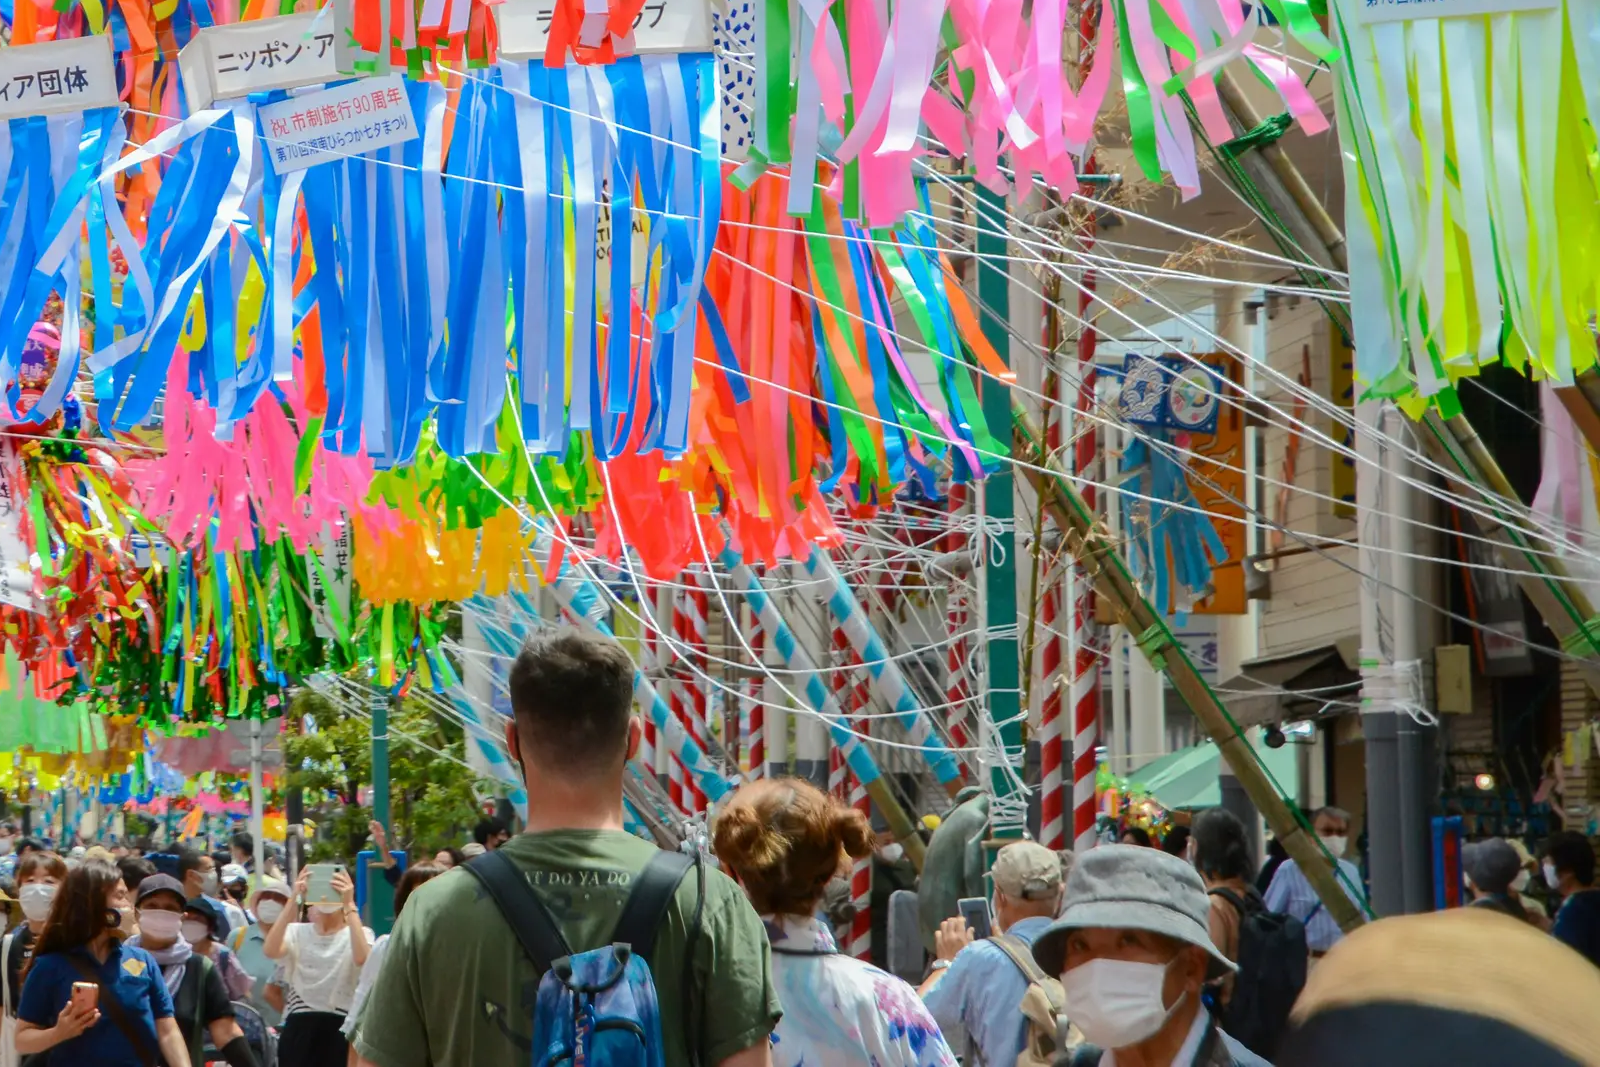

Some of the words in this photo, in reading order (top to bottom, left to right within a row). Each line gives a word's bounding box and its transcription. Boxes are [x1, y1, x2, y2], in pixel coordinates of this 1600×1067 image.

[548, 871, 573, 885] DO
[579, 871, 600, 886] YA
[607, 870, 631, 885] DO
